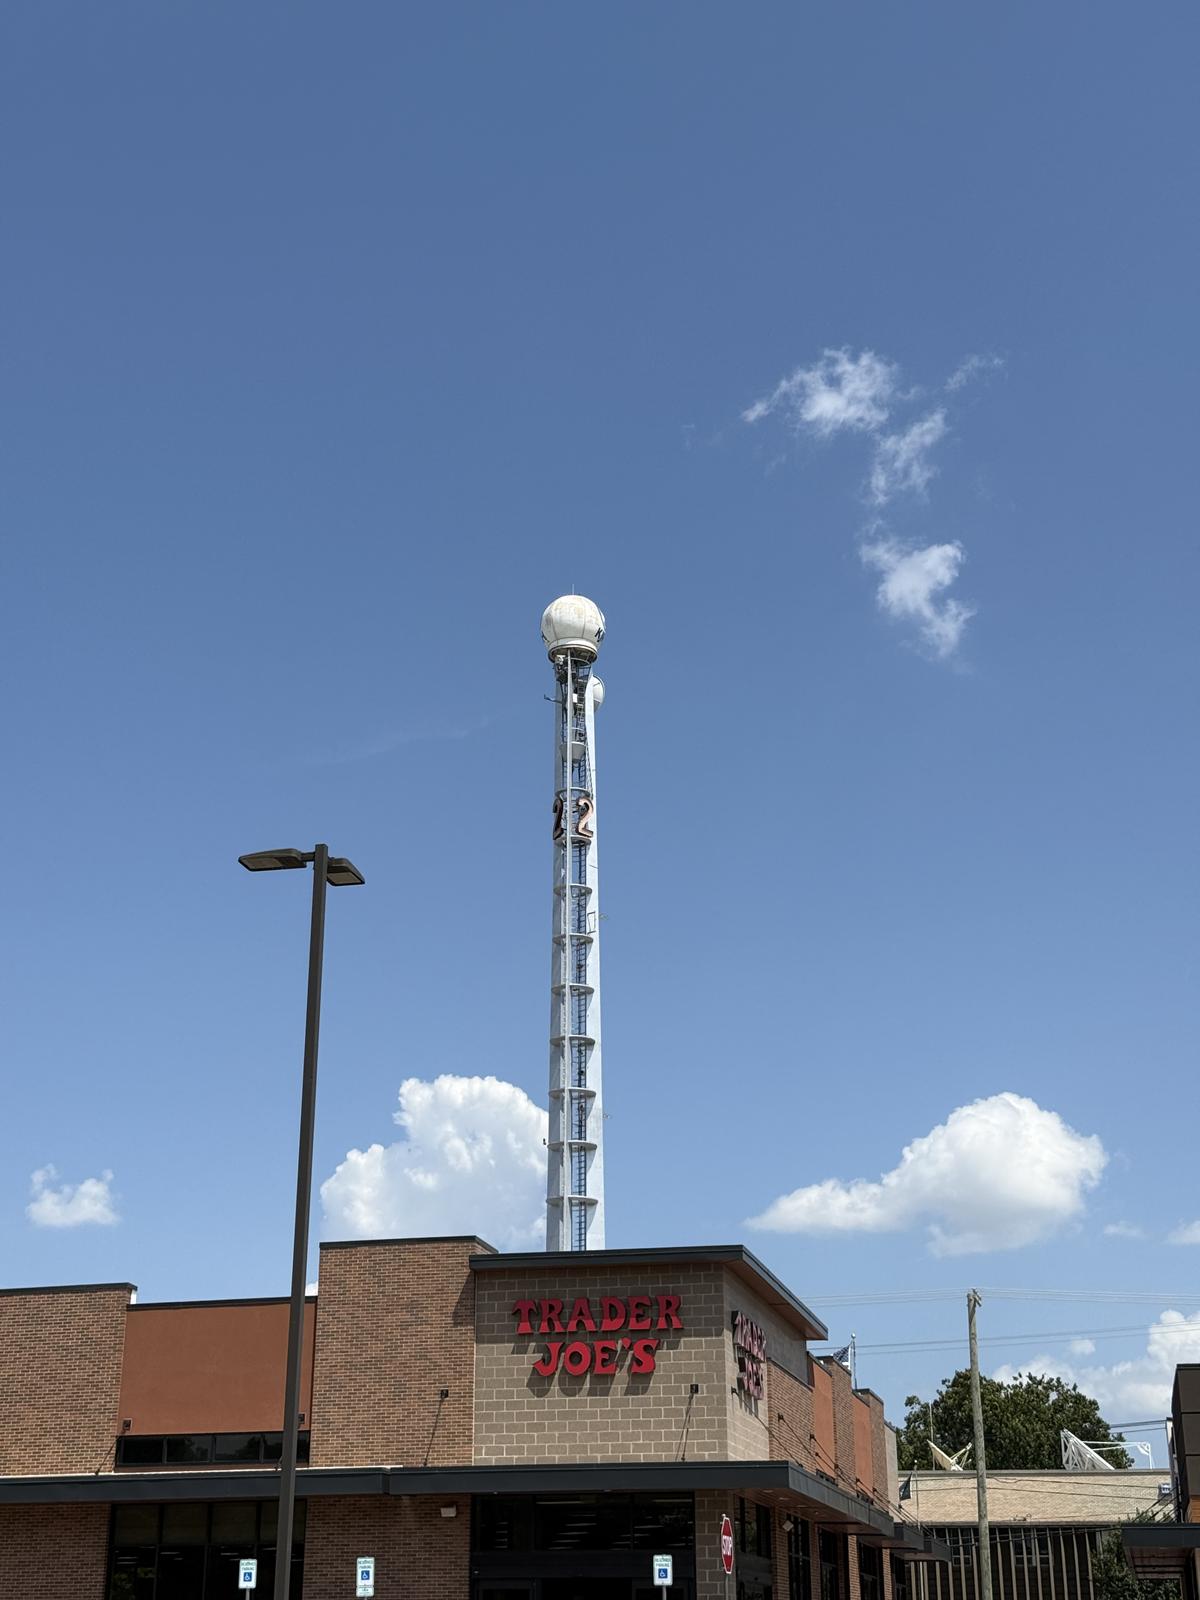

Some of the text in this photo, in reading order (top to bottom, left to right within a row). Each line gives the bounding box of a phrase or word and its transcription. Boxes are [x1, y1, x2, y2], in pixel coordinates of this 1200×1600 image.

[576, 797, 594, 838] 2
[511, 1295, 684, 1335] TRADER
[533, 1337, 661, 1377] JOE'S
[722, 1535, 733, 1556] STOP
